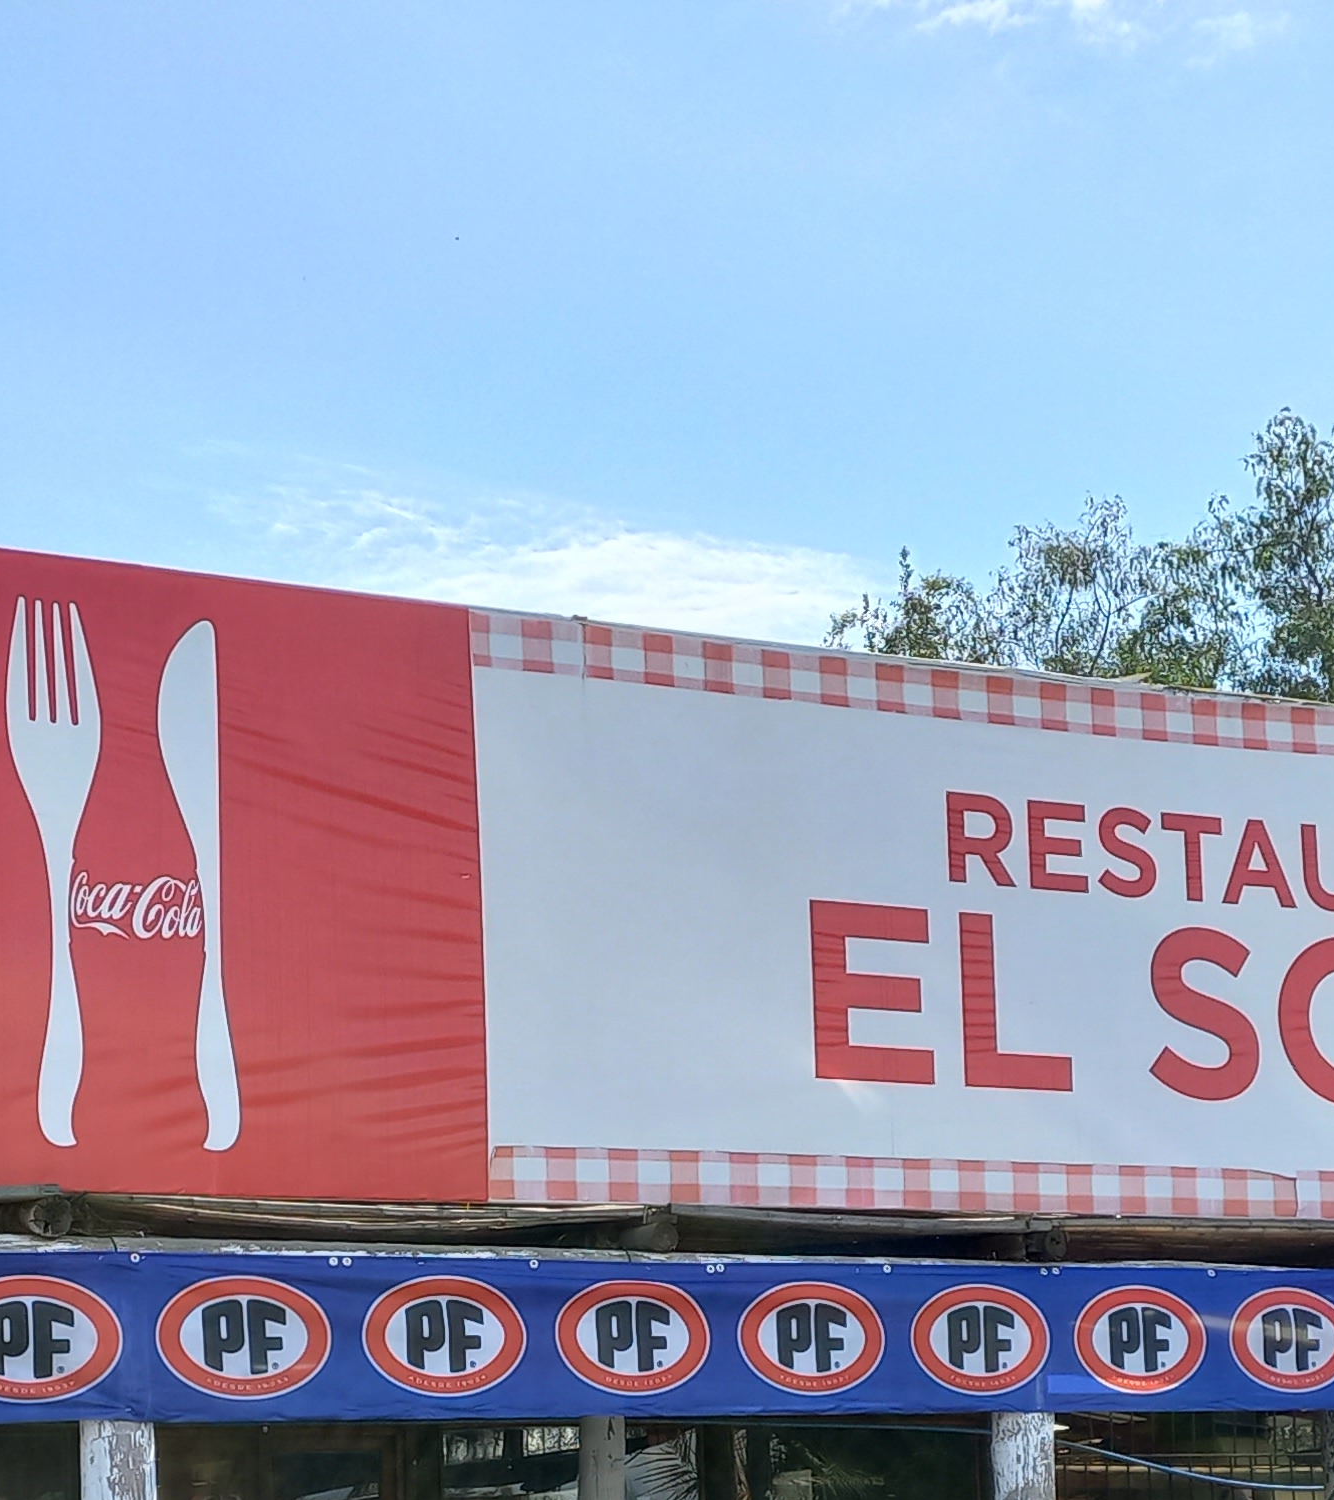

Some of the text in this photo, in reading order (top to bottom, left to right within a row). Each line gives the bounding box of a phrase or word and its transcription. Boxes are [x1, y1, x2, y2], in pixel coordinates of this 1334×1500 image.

[70, 871, 203, 940] Coca-Cola
[808, 898, 1074, 1093] EL
[201, 1298, 287, 1375] PF
[404, 1300, 485, 1374] PF
[595, 1300, 671, 1372] PF
[775, 1302, 848, 1373] PF
[946, 1305, 1016, 1373] PF
[1107, 1306, 1173, 1373] PF
[1261, 1308, 1324, 1372] PF
